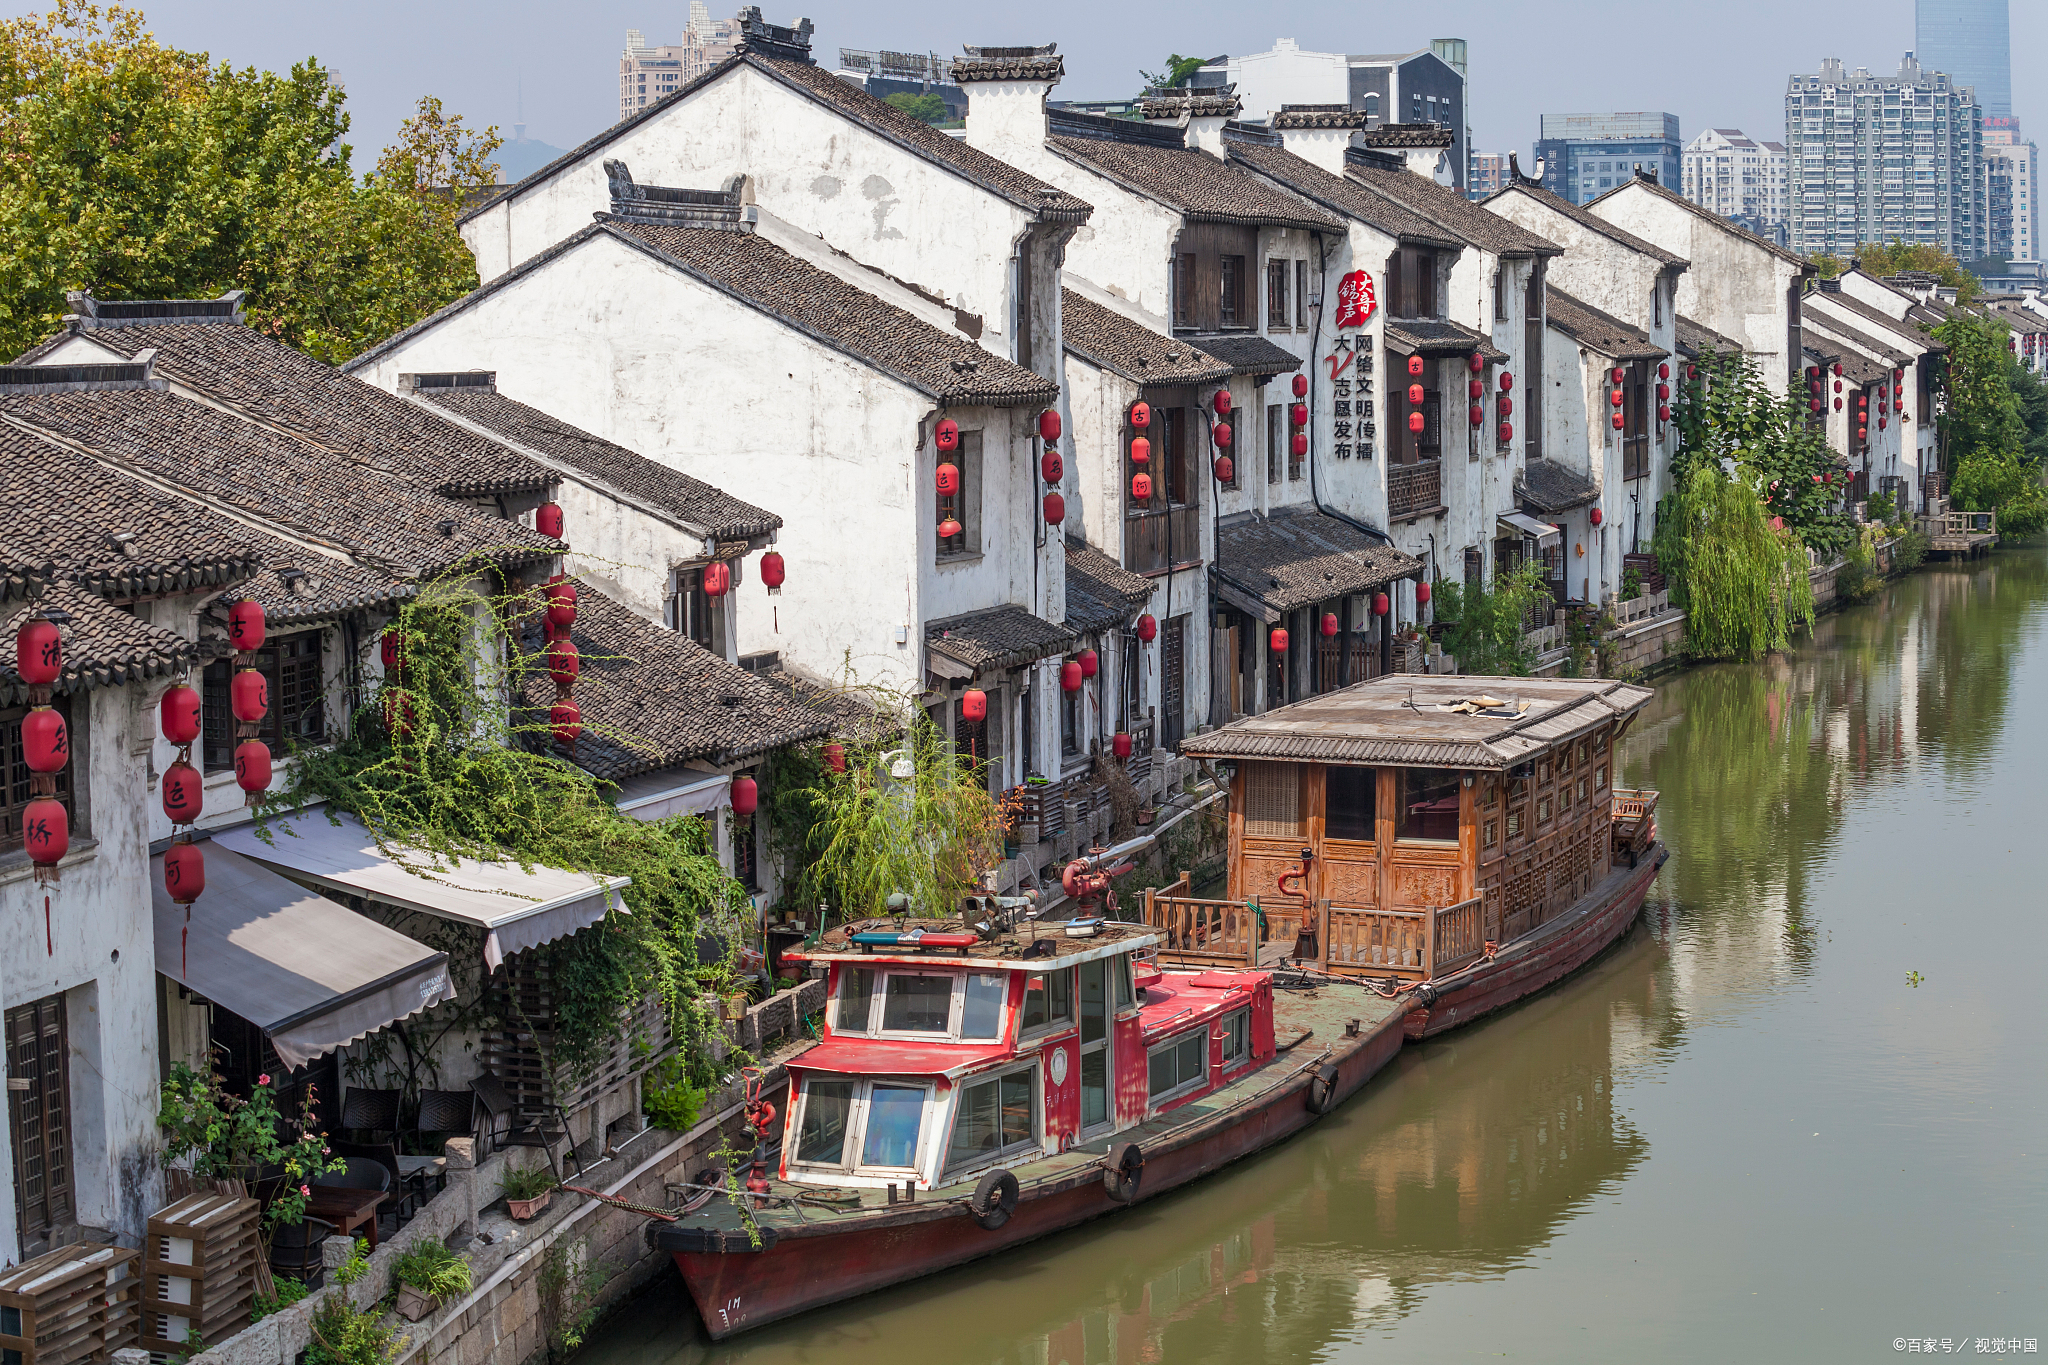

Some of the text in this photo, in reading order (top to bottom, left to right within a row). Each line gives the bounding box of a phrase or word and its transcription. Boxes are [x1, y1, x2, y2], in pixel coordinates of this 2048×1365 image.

[1355, 334, 1375, 461] 网络文明传播
[941, 428, 953, 442] 古
[230, 614, 246, 638] 古
[165, 782, 187, 809] 运
